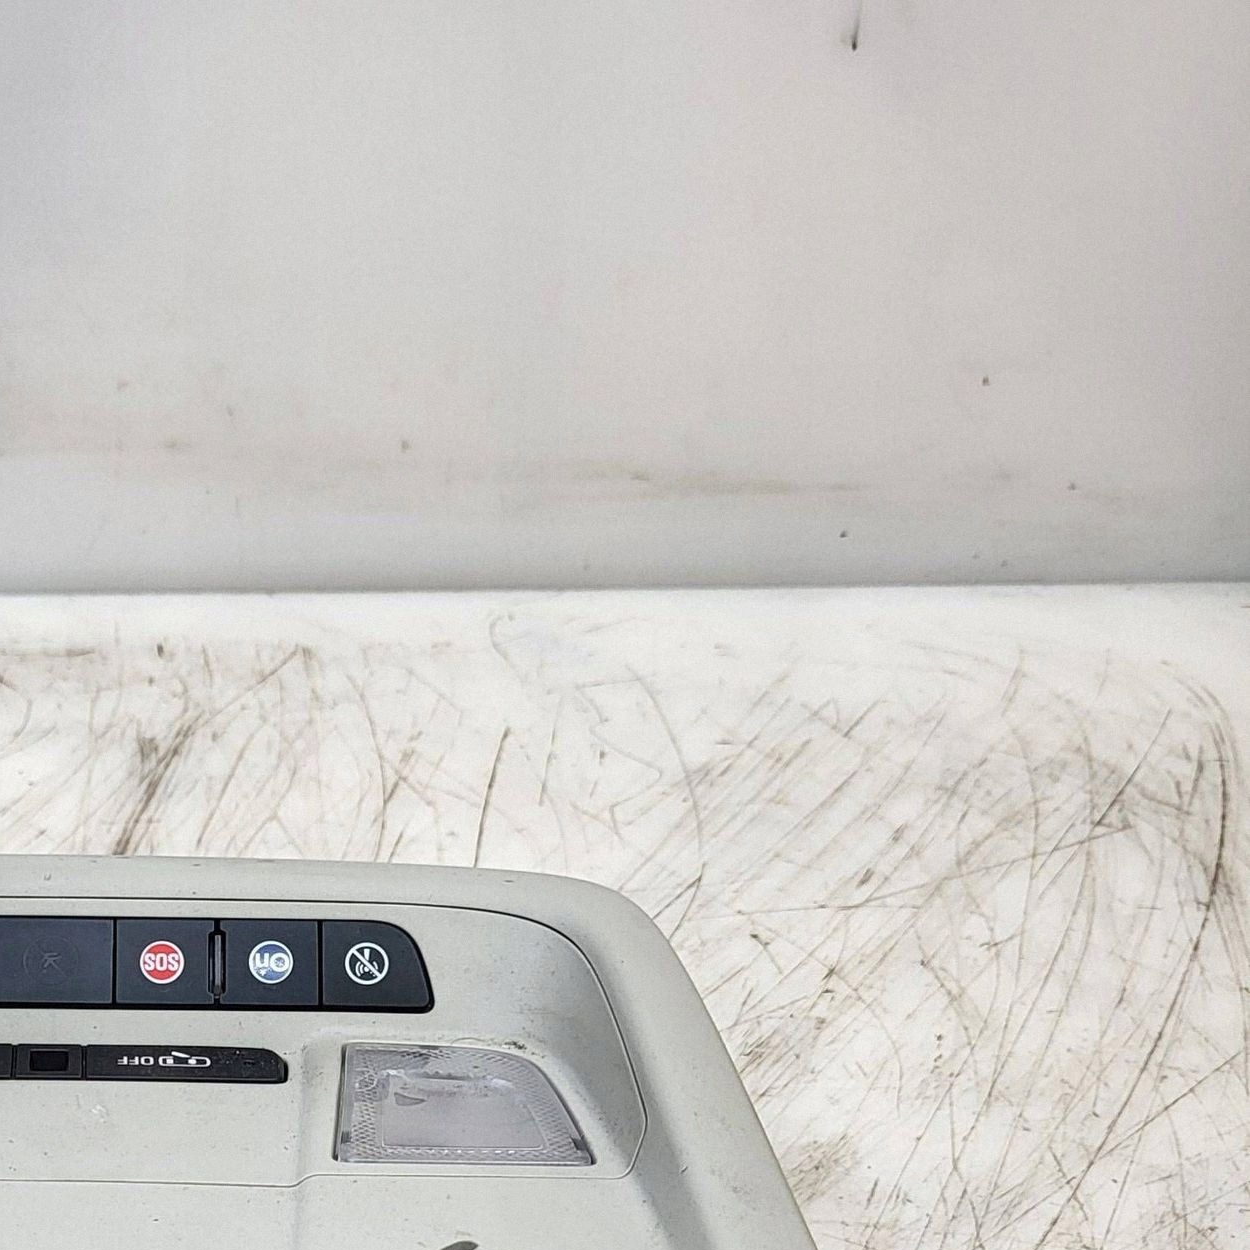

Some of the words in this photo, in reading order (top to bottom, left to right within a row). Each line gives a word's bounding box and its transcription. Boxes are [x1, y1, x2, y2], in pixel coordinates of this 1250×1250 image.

[143, 952, 180, 970] SOS
[255, 951, 290, 969] On
[117, 1055, 154, 1066] OFF
